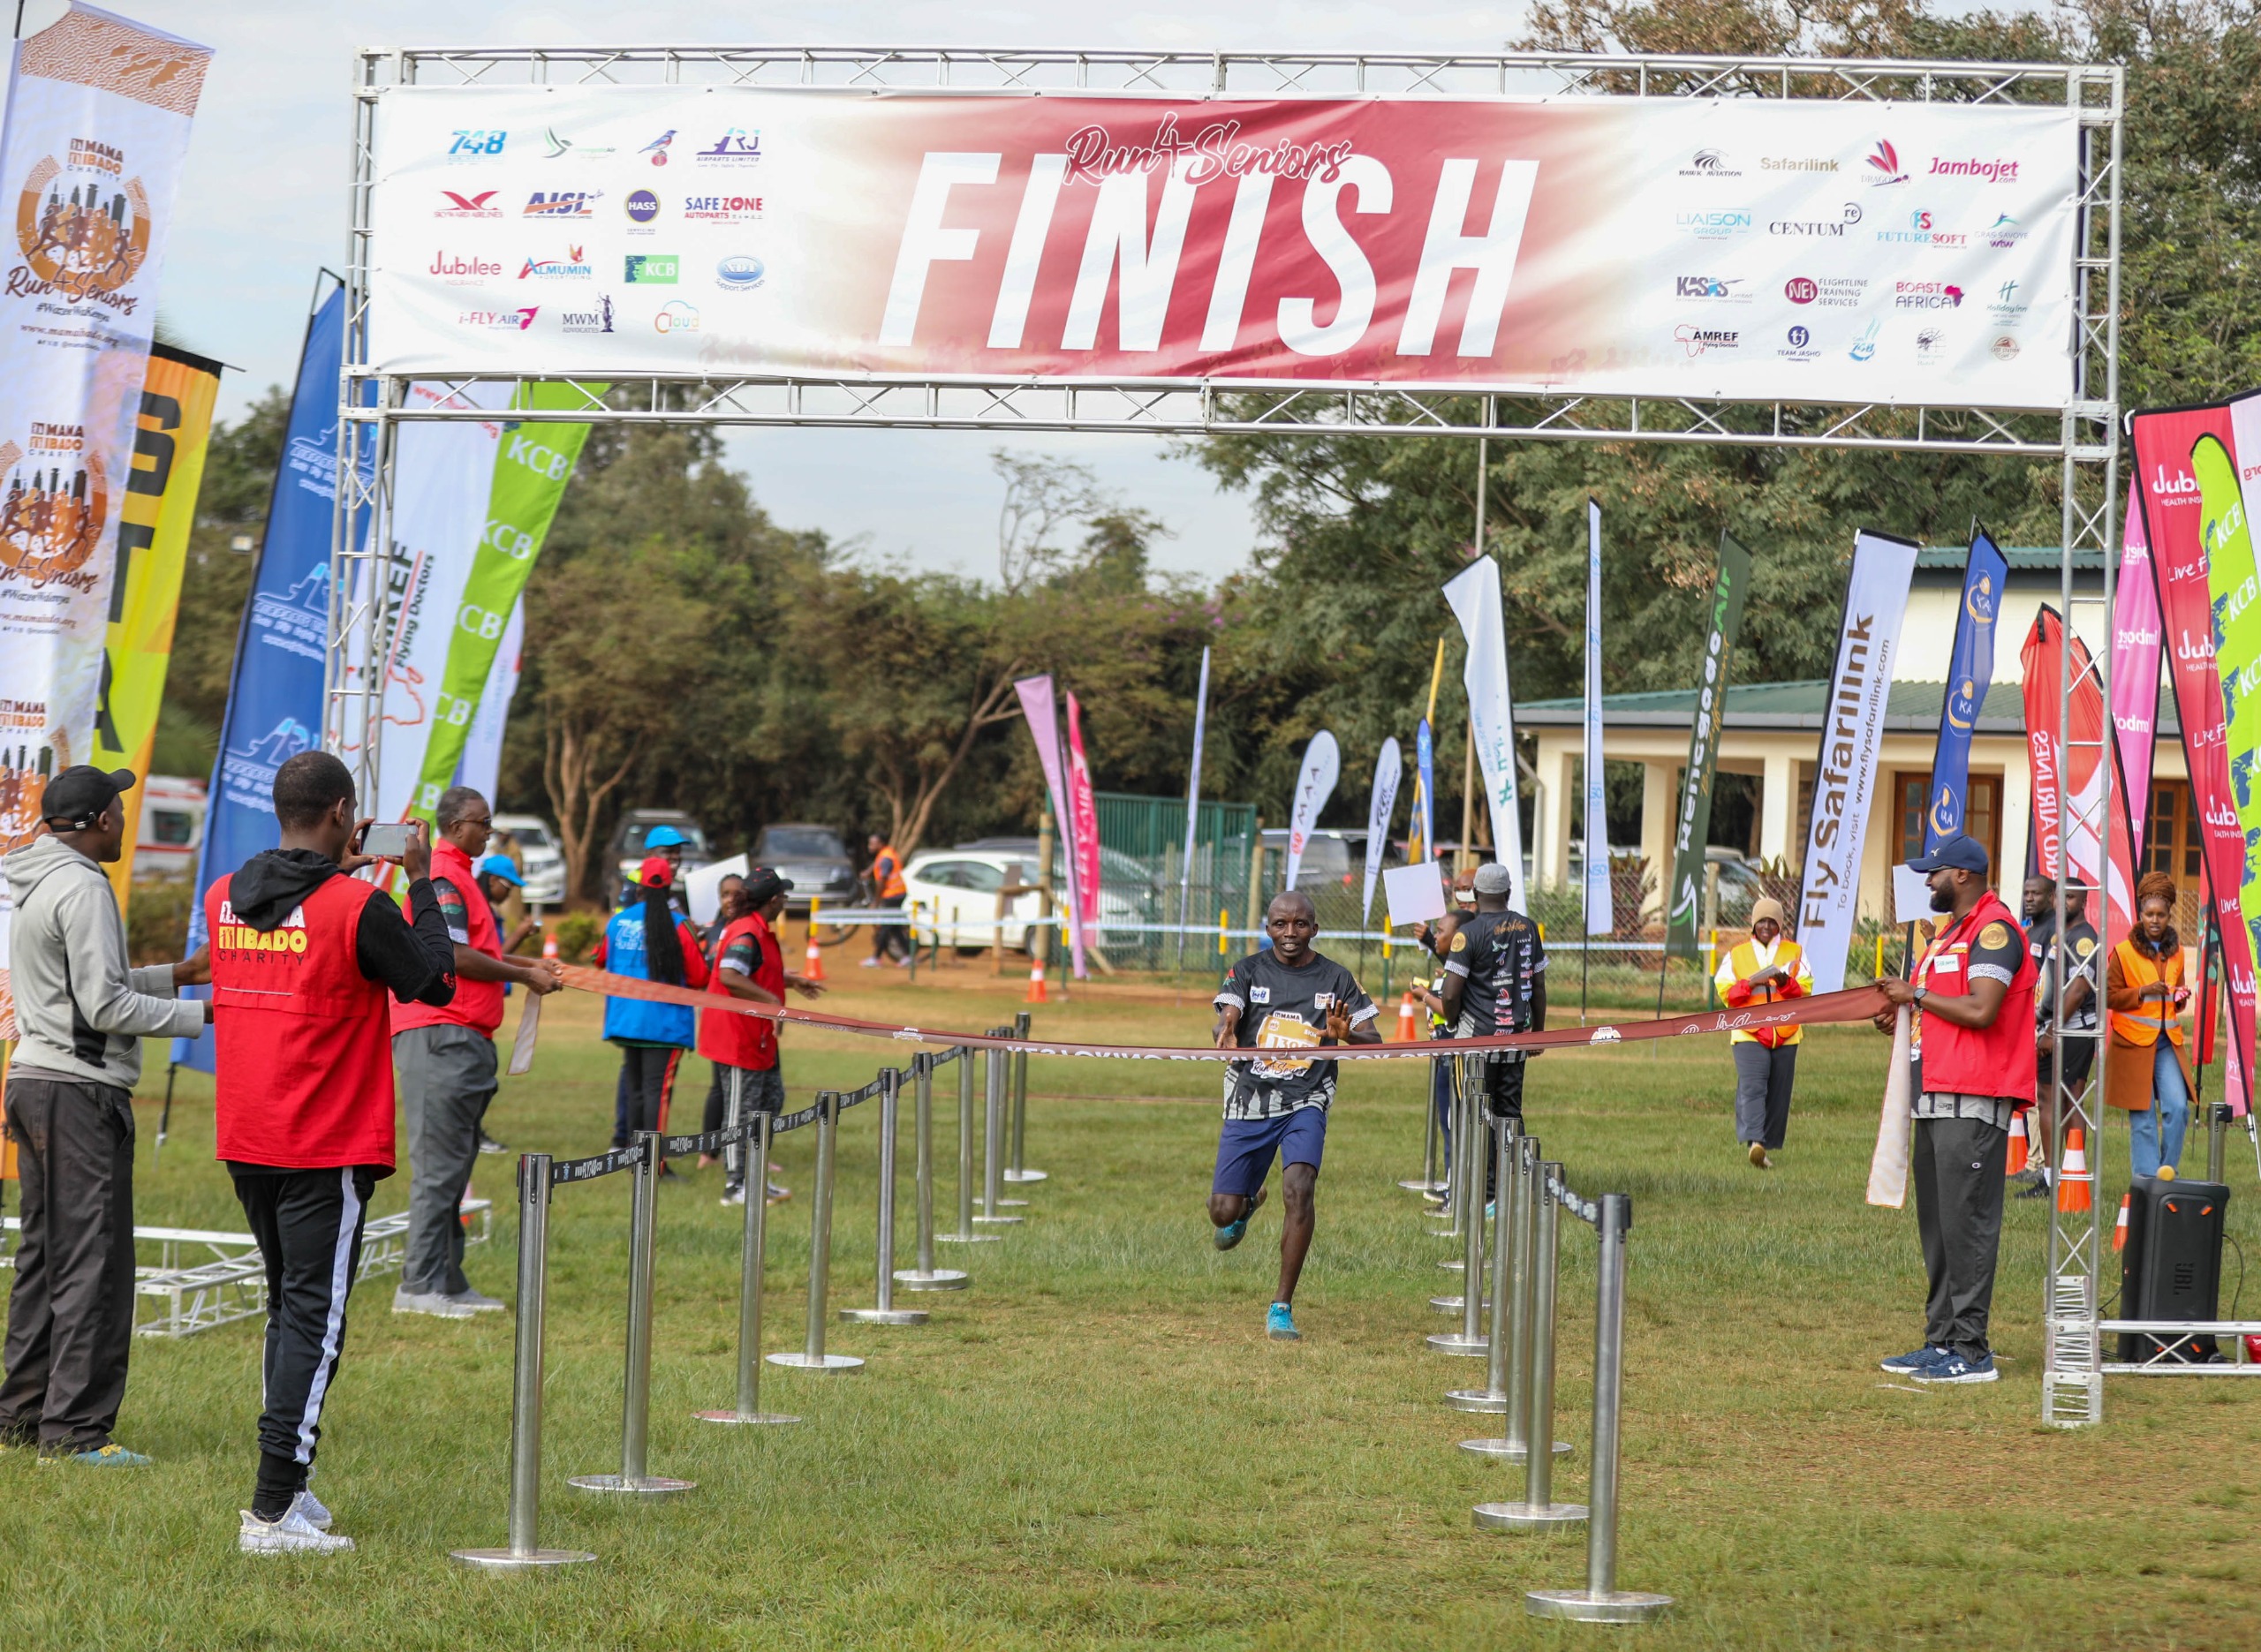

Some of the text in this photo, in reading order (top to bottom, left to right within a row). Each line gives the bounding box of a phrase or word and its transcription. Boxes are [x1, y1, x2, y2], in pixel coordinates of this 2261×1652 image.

[448, 130, 507, 155] 748
[85, 140, 124, 163] MAMA
[1760, 157, 1840, 173] Safarilink
[1929, 157, 2020, 183] Jambojet
[66, 164, 121, 183] CHARITY
[1860, 174, 1913, 185] DRAGOLY
[523, 192, 593, 215] AISL
[628, 201, 657, 211] HASS
[684, 196, 763, 211] SAFE ZONE
[1675, 212, 1751, 227] LIAISON
[1843, 207, 1858, 218] re
[1694, 227, 1732, 236] GROUP
[1769, 221, 1845, 237] CENTUM
[1997, 230, 2029, 240] SAVOYE
[1877, 231, 1967, 245] FUTURESOFT
[1989, 238, 2015, 248] wtw
[429, 249, 502, 275] Jubilee
[877, 152, 1539, 358] FINISH
[518, 257, 592, 280] ALMUMIN
[645, 262, 676, 276] KCB
[714, 277, 739, 292] Support
[1819, 279, 1869, 288] FLIGHTLINE
[1896, 283, 1941, 294] BOAST
[1819, 289, 1862, 298] TRAINING
[1818, 298, 1858, 307] SERVICES
[1895, 296, 1952, 309] AFRICA
[459, 312, 520, 325] i-FLY AIR
[562, 313, 600, 325] MWM
[654, 313, 699, 334] Cloud
[1693, 331, 1739, 342] AMREF
[47, 424, 84, 439] MAMA
[28, 449, 83, 459] CHARITY
[507, 434, 569, 481] KCB
[2160, 496, 2188, 507] HEALTH
[2215, 502, 2242, 549] KCB
[2167, 562, 2196, 583] Live
[2228, 574, 2257, 622] KCB
[394, 554, 435, 668] Flying Doctors
[457, 600, 503, 640] CB
[1803, 612, 1874, 929] Fly Safarilink
[1836, 638, 1890, 911] To book, visit www.flysafarilink.com
[2213, 829, 2230, 838] EALTH
[2220, 896, 2239, 914] Live
[236, 926, 307, 954] IBADO
[219, 951, 305, 966] CHARITY
[2173, 1262, 2197, 1297] JBL
